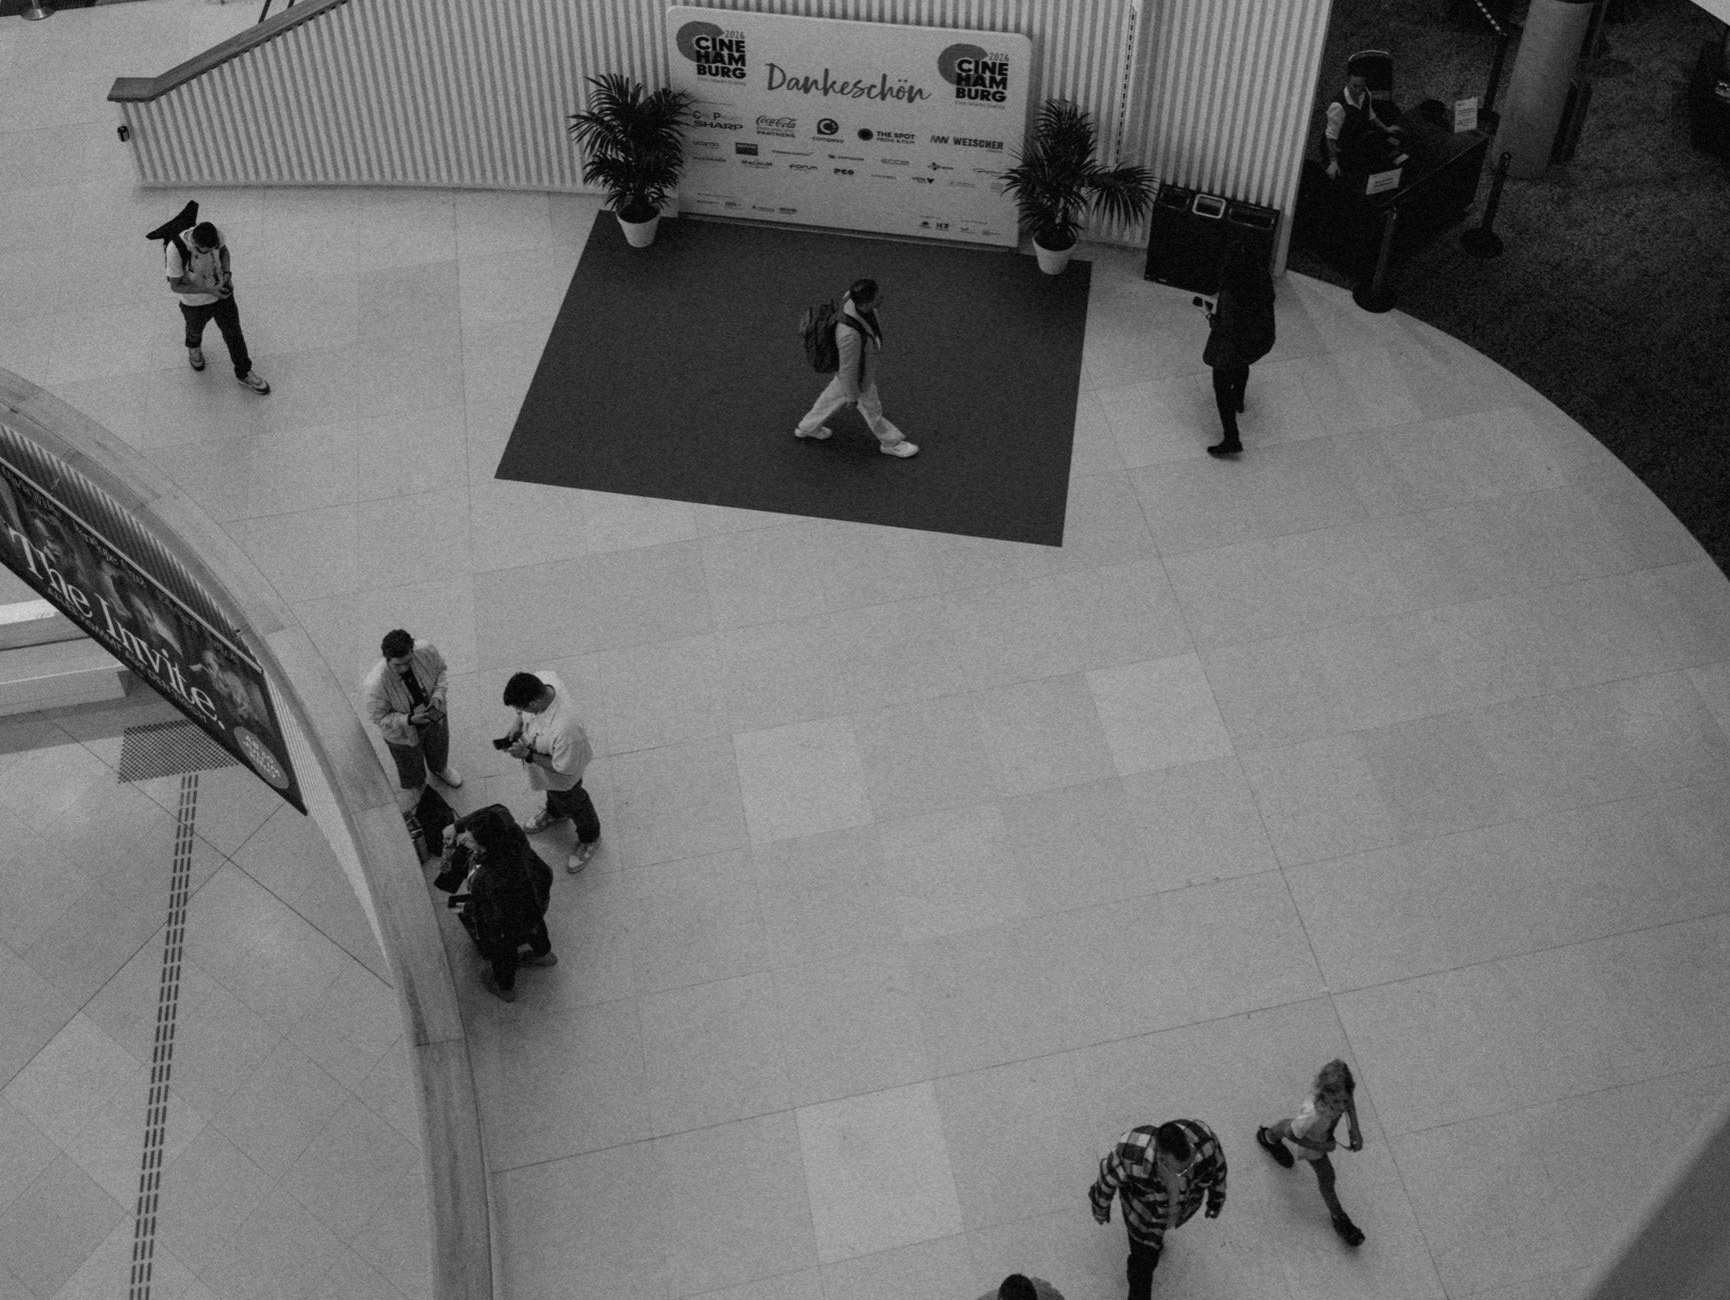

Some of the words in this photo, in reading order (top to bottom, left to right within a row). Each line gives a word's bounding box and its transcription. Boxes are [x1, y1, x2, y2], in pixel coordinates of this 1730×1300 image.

[725, 29, 746, 39] 2026
[695, 36, 746, 53] CINE
[696, 50, 746, 67] HAM
[988, 53, 1009, 62] 2026
[697, 64, 747, 79] BURG
[957, 59, 1009, 76] CINE
[765, 63, 932, 104] Dankeschön
[956, 72, 1008, 90] HAM
[955, 87, 1007, 102] BURG
[694, 120, 743, 131] SHARP
[894, 132, 915, 140] SPOT
[953, 136, 1004, 150] WEISCHER
[8, 525, 93, 619] The
[94, 592, 226, 731] Invite.
